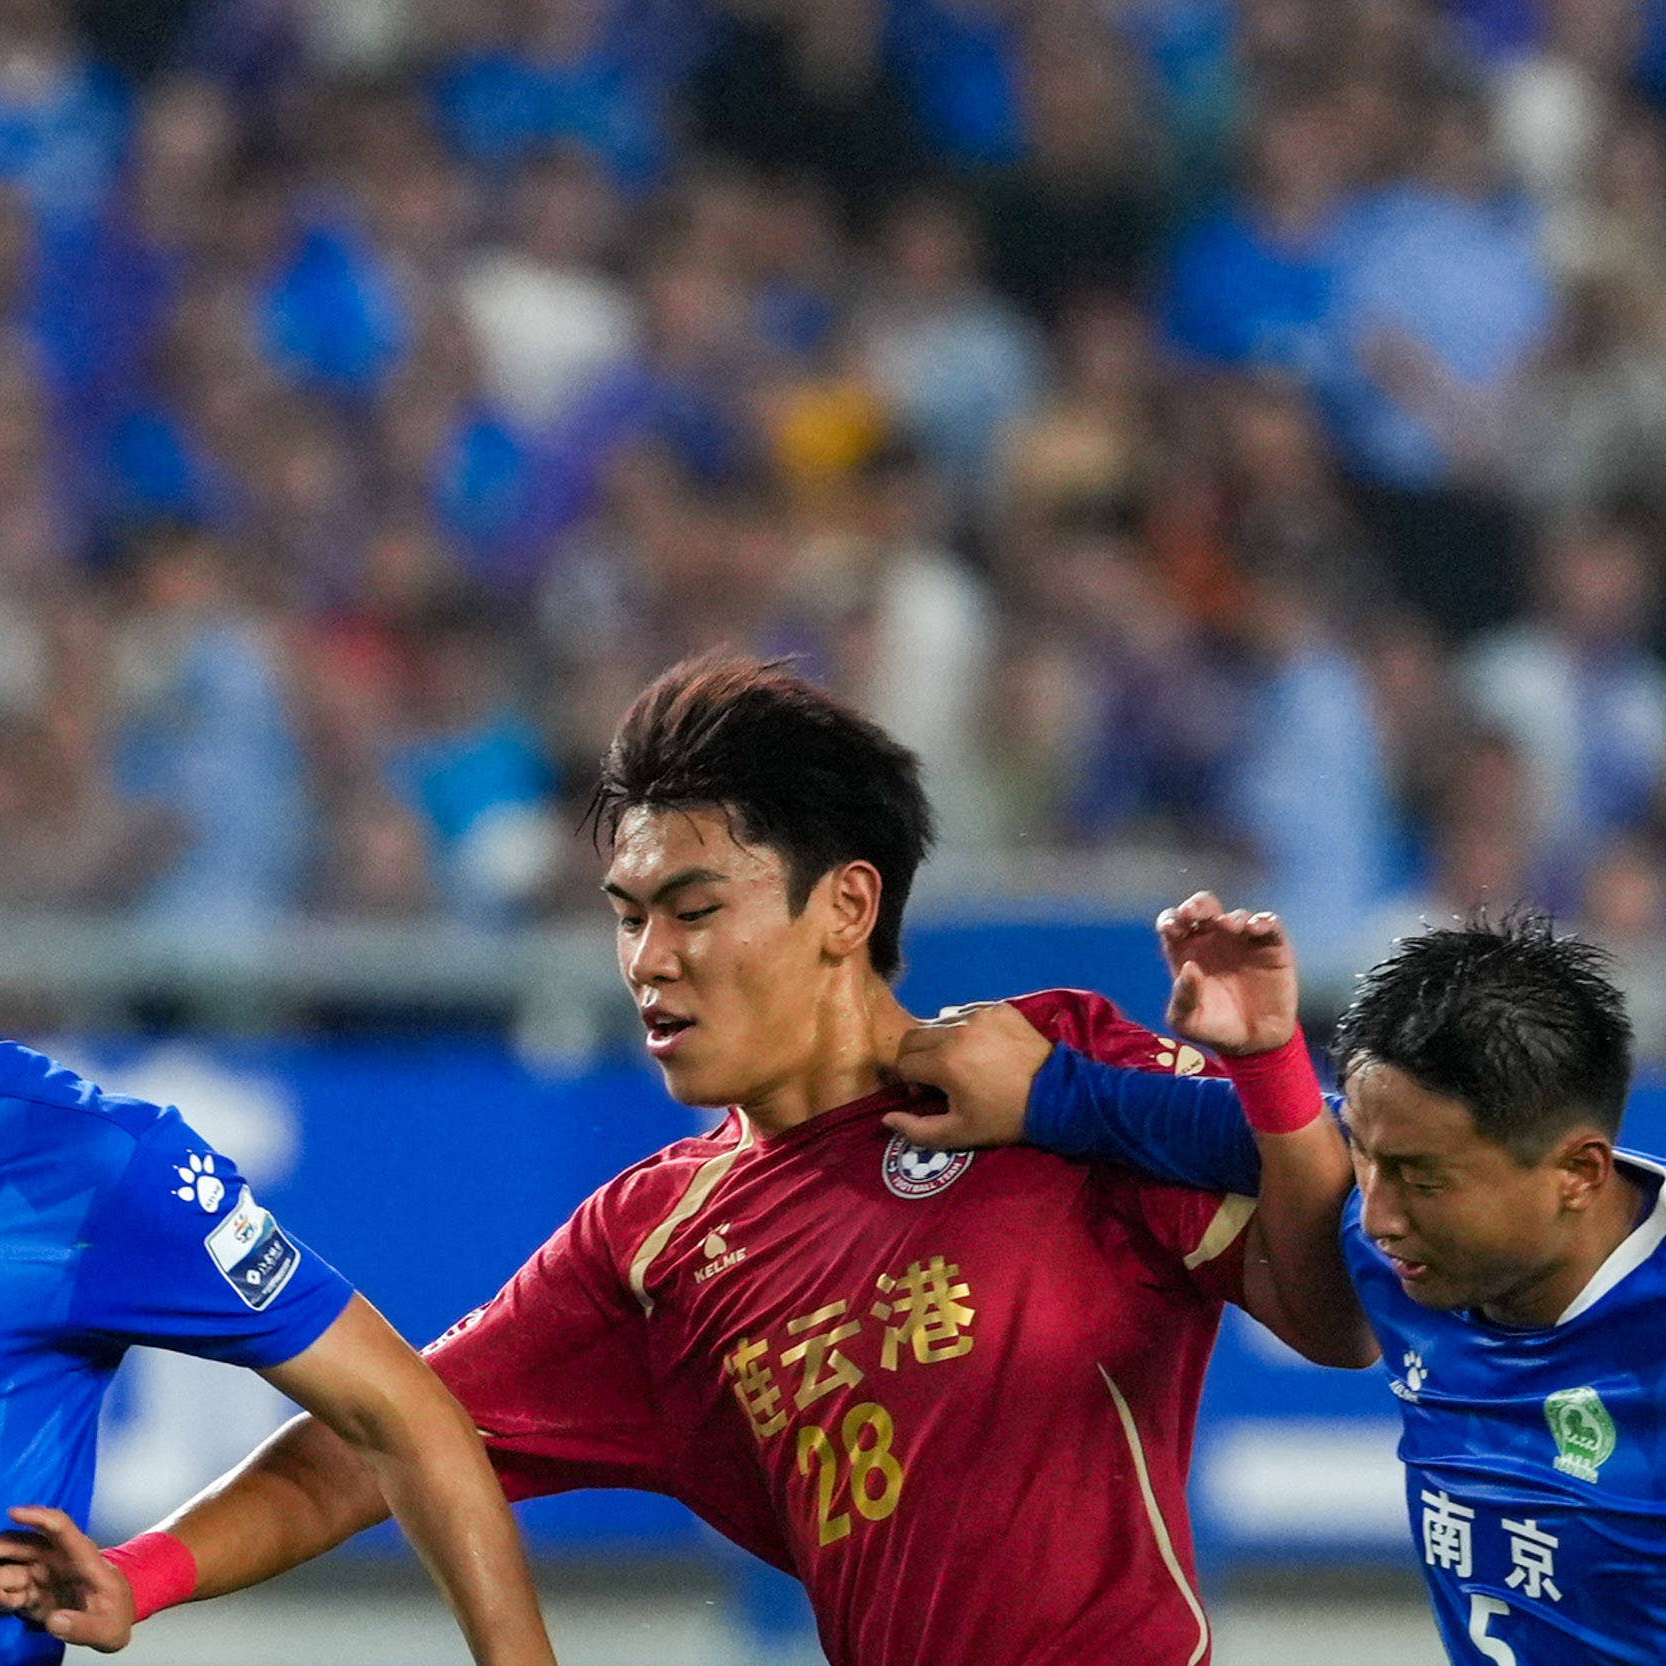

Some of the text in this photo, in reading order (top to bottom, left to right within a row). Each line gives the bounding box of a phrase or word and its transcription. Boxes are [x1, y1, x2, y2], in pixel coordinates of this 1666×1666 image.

[693, 1246, 747, 1284] KELME
[722, 1255, 976, 1438] 连云港
[797, 1402, 904, 1547] 28
[1421, 1489, 1563, 1603] 南京
